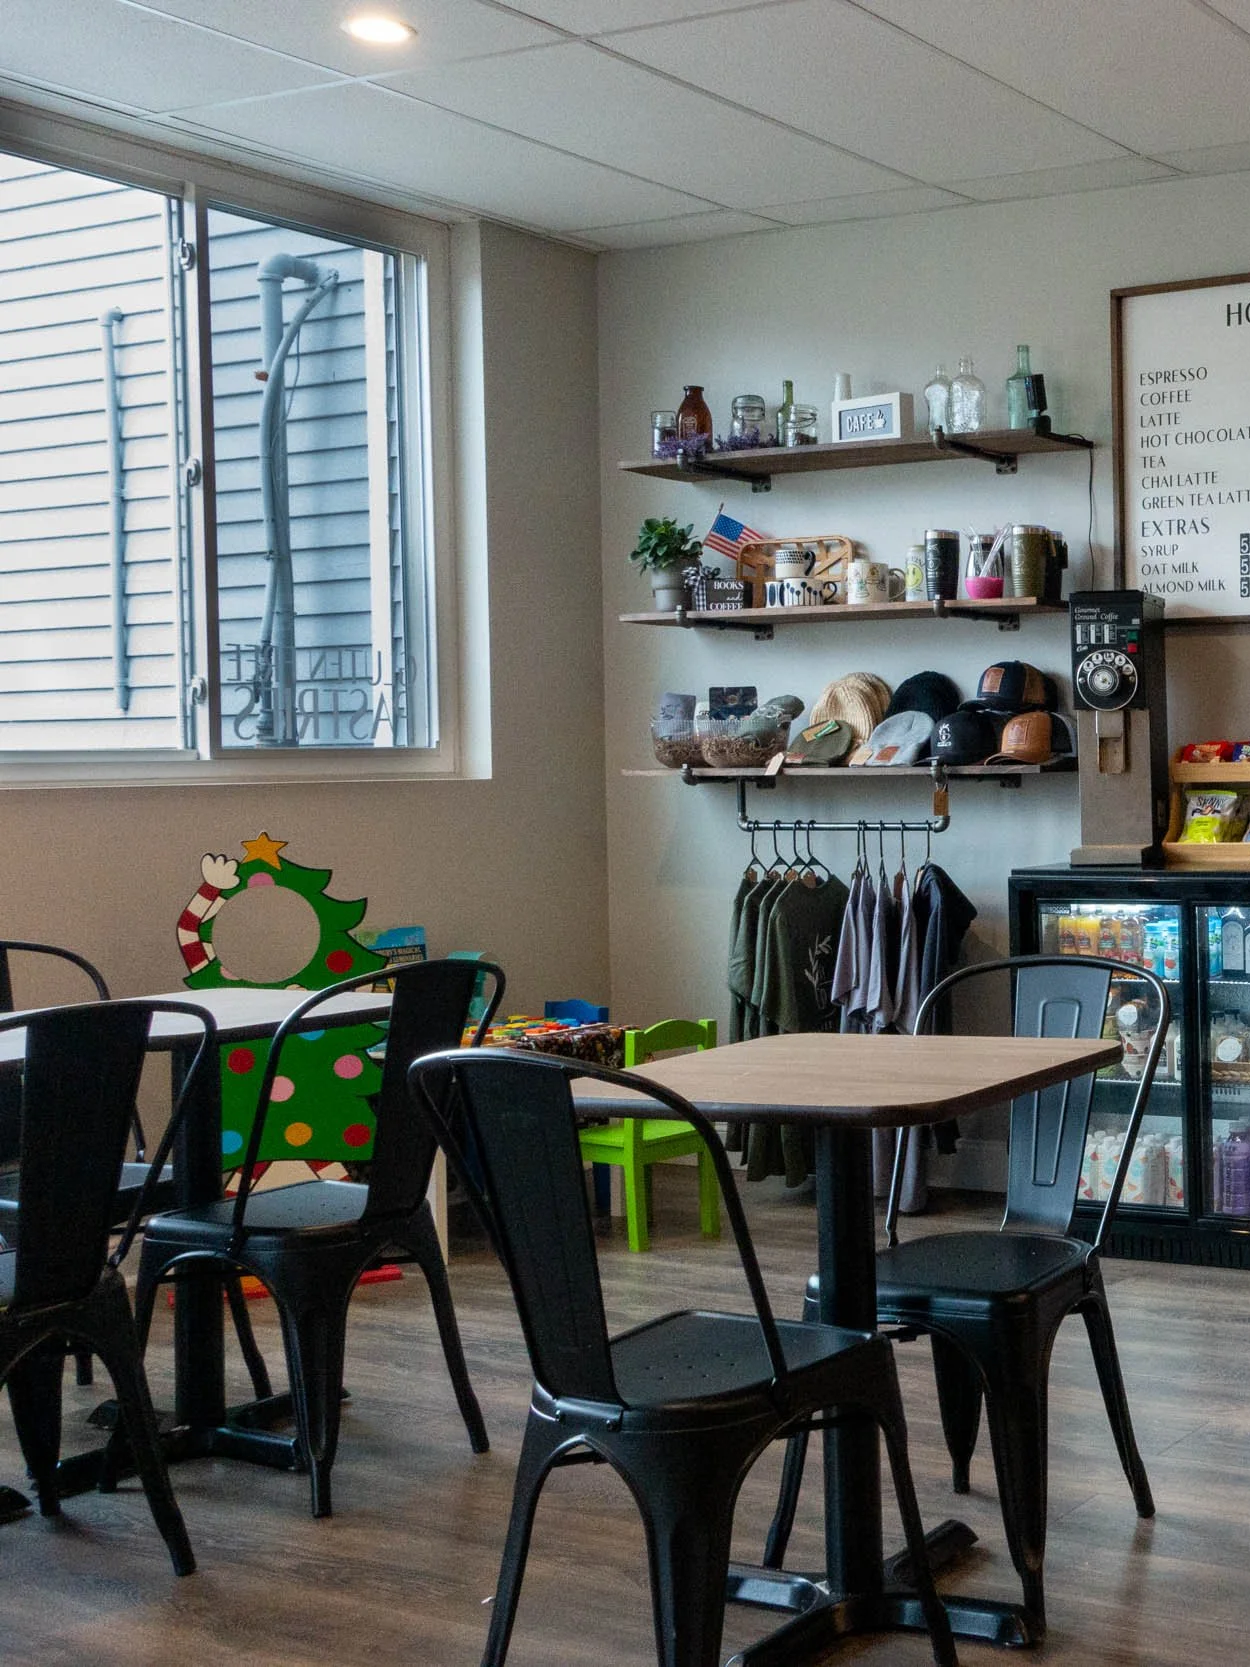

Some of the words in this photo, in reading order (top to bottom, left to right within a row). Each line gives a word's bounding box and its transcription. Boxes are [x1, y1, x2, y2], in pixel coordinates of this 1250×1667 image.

[1139, 366, 1208, 386] ESPRESSO
[1140, 389, 1193, 406] COFFEE
[846, 412, 873, 433] CAFE
[1140, 412, 1181, 428] LATTE
[1140, 432, 1174, 449] HOT
[1141, 455, 1166, 469] TEA
[1141, 473, 1173, 489] CHAI
[1177, 470, 1218, 487] LATTE
[1142, 493, 1184, 510] GREEN
[1189, 491, 1214, 507] TEA
[1141, 517, 1210, 538] EXTRAS
[1141, 543, 1179, 557] SYRUP
[1141, 562, 1168, 576] OAT
[1171, 561, 1199, 575] MILK
[713, 581, 744, 590] BOOKS
[1141, 580, 1194, 594] ALMOND
[1198, 579, 1226, 592] MILK
[1100, 613, 1119, 621] Coffee
